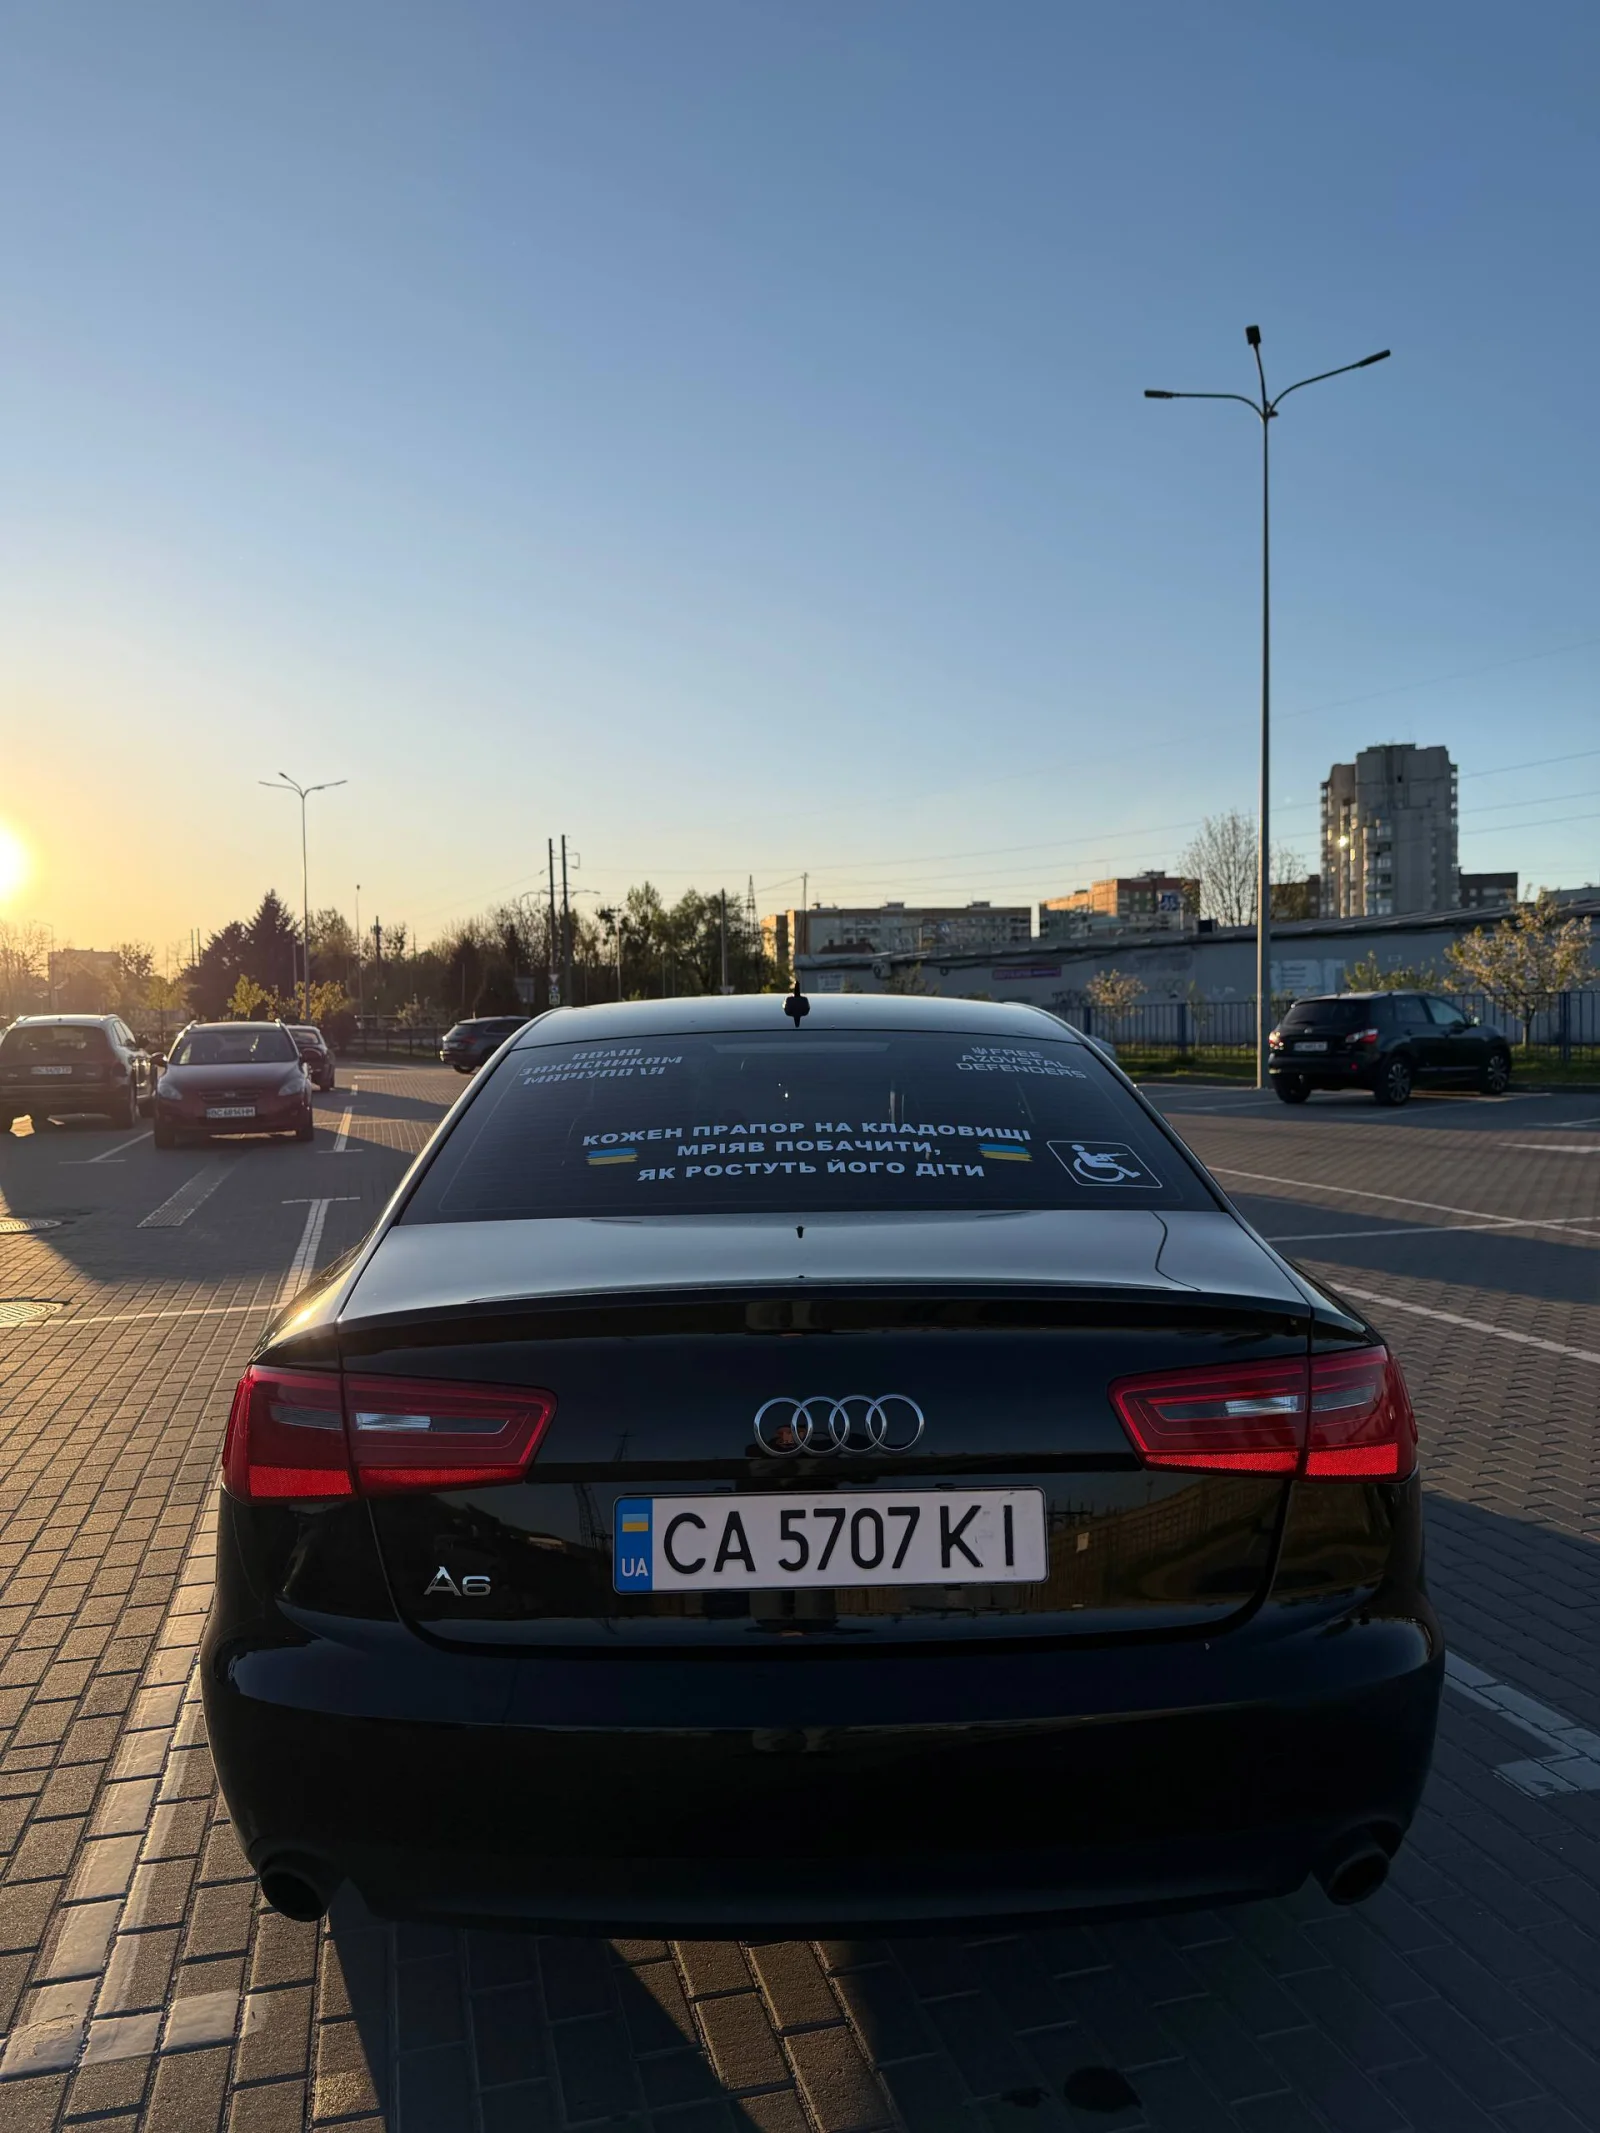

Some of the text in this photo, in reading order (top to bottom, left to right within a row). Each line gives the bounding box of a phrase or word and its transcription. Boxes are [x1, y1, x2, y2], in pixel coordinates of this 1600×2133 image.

[961, 1054, 1072, 1070] AZOVSTAL
[989, 1048, 1044, 1059] FREE
[519, 1056, 683, 1077] ЗАХИСНИКАМ
[956, 1062, 1087, 1079] DEFENDERS
[581, 1122, 1032, 1146] КОЖЕН ПРАПОР НА КЛАДОВИЩІ
[676, 1139, 941, 1156] МРІЯВ ПОБАЧИТИ,
[636, 1158, 985, 1182] ЯК РОСТУТЬ ЙОГО ДІТИ
[663, 1510, 756, 1575] CA
[777, 1506, 921, 1572] 5707
[621, 1557, 649, 1578] UA
[423, 1565, 492, 1597] A6
